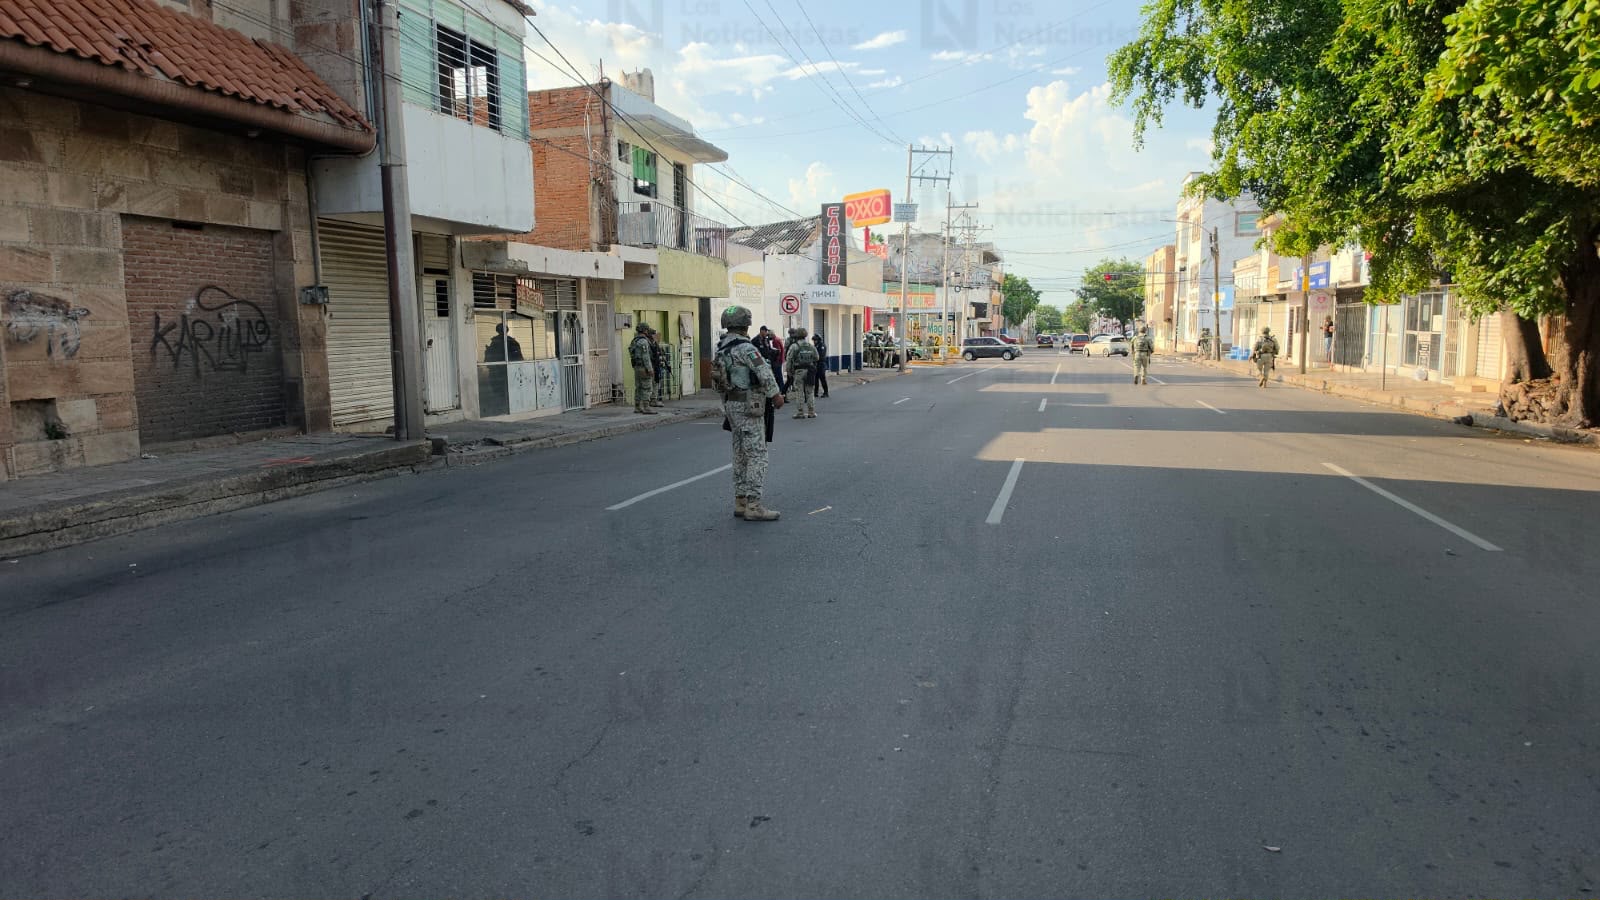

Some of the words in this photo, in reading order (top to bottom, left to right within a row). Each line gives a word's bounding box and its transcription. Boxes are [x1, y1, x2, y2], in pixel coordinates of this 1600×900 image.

[827, 207, 840, 236] CAR
[845, 197, 883, 221] OXXO
[827, 237, 840, 284] AUDIO
[928, 324, 953, 336] Maga
